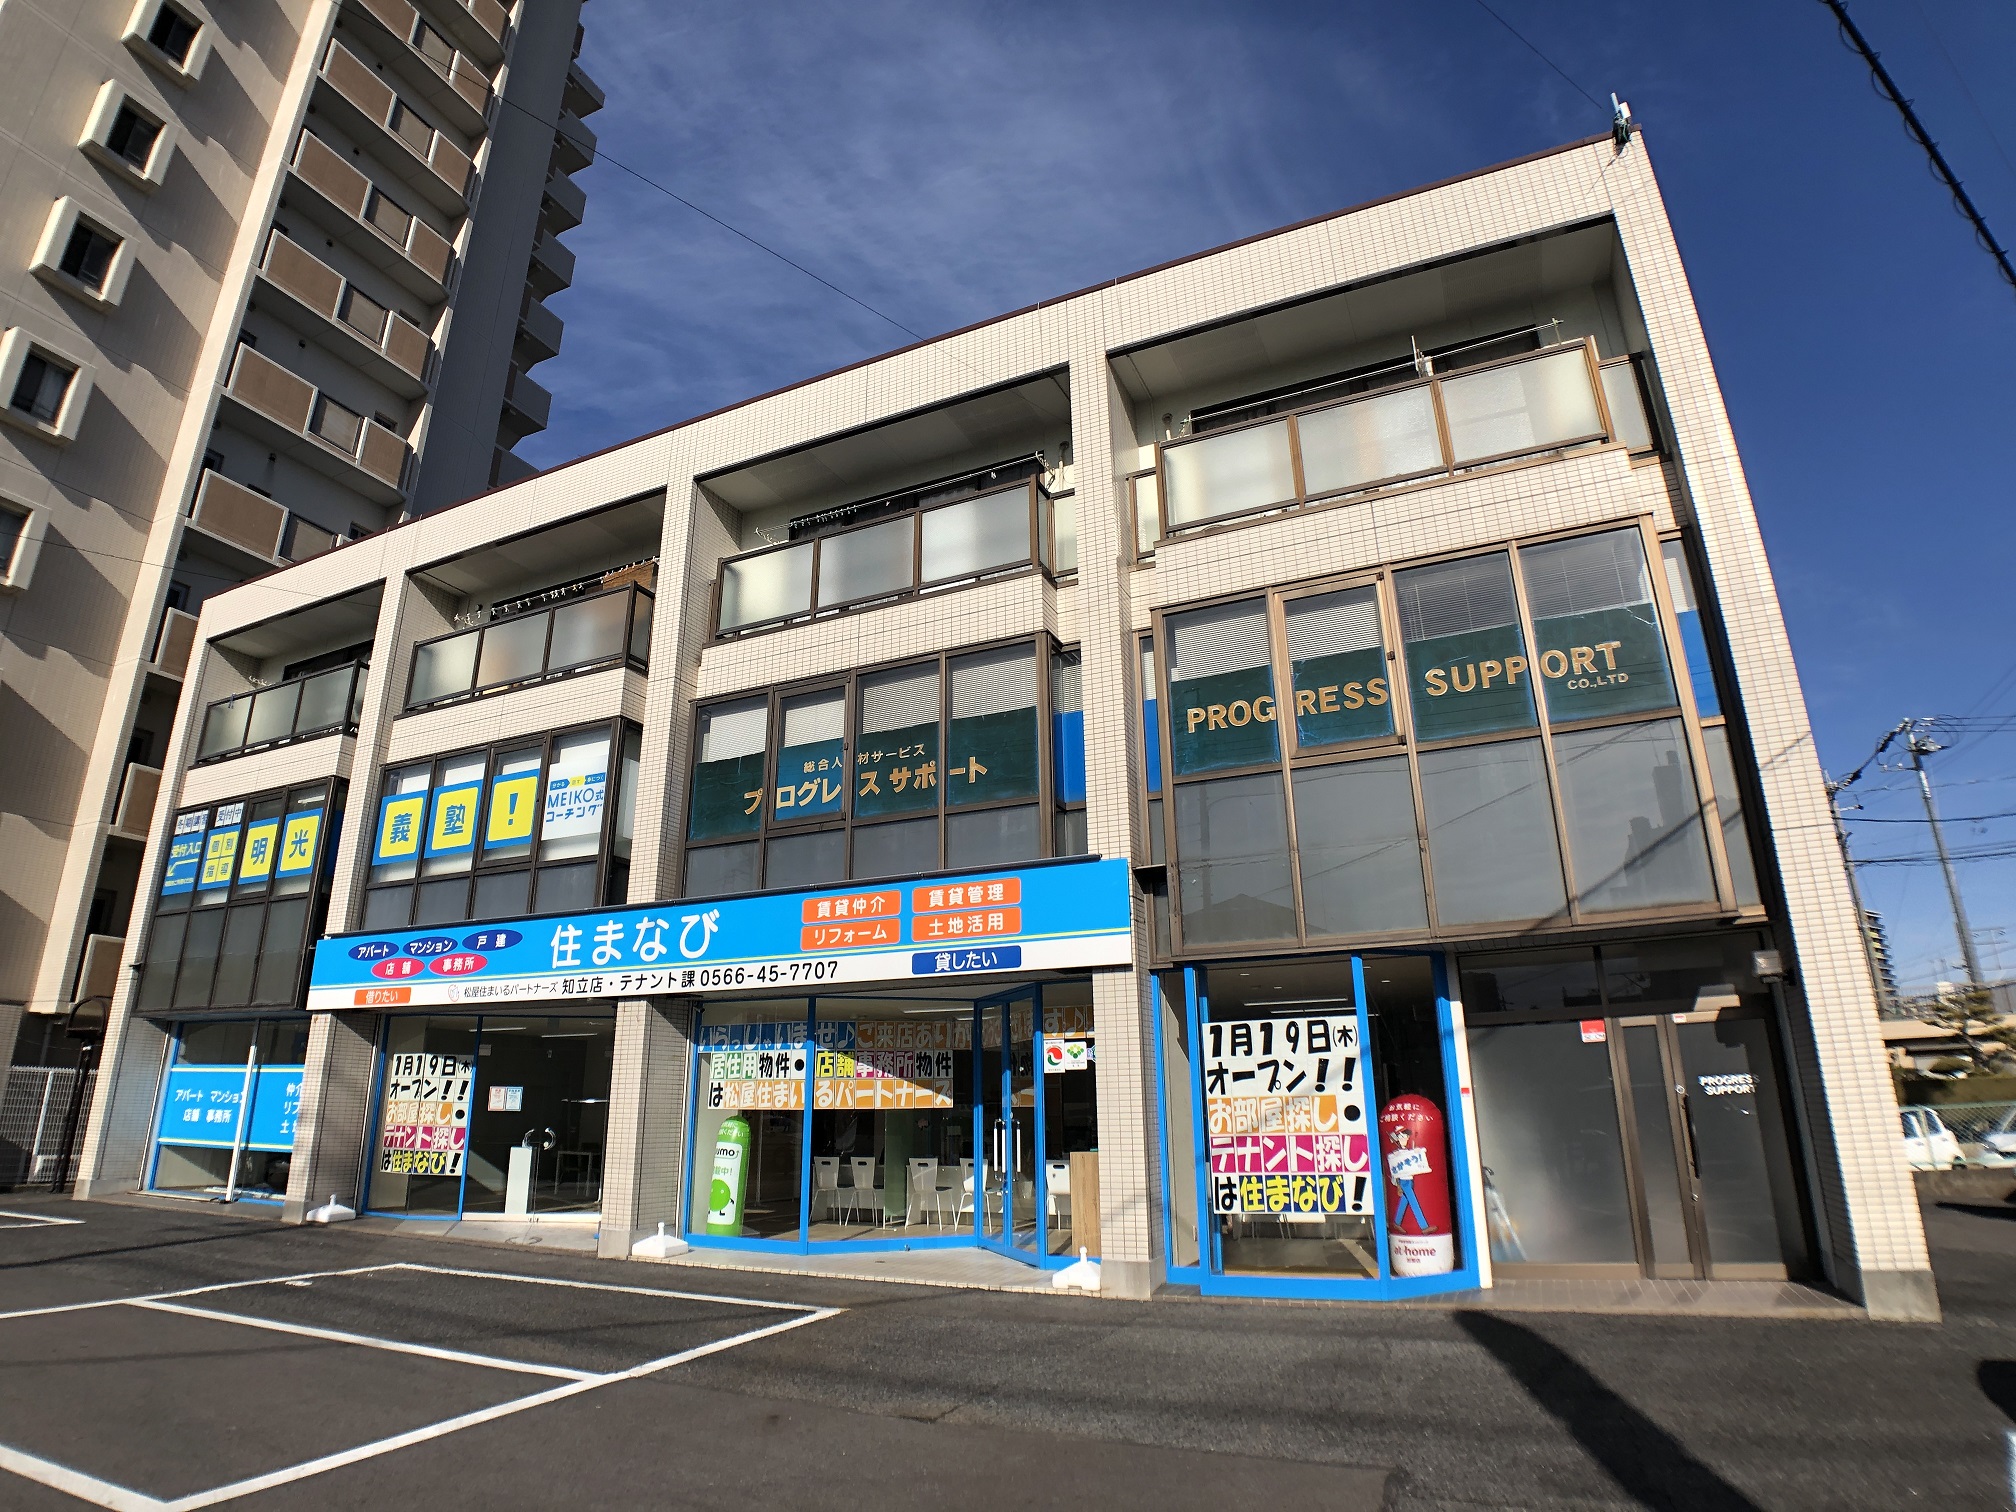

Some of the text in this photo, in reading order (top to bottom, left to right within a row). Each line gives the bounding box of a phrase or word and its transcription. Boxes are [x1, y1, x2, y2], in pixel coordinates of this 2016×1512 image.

[1187, 641, 1623, 734] PROGRESS SUPPORT
[889, 757, 988, 794] サポート
[546, 804, 603, 822] コーチング
[929, 883, 1004, 906] 賃貸管理
[817, 896, 886, 917] 賃貸仲介
[929, 913, 1004, 936] 土地活用
[550, 908, 721, 969] 住まなび
[814, 925, 888, 945] リフォーム
[357, 944, 390, 959] アパート
[409, 938, 453, 954] マンション
[442, 957, 475, 971] 事務所
[934, 950, 998, 972] 貸したい
[700, 960, 838, 987] 0566-45-7707
[365, 990, 399, 1004] 借りたい
[1699, 1074, 1760, 1087] PROGRESS
[1704, 1084, 1757, 1096] SUPPORT
[174, 1088, 203, 1102] アパート
[206, 1109, 232, 1123] 事務所
[383, 1126, 465, 1149] テナント探し
[1211, 1136, 1369, 1173] テナント探し
[1404, 1245, 1437, 1256] home
